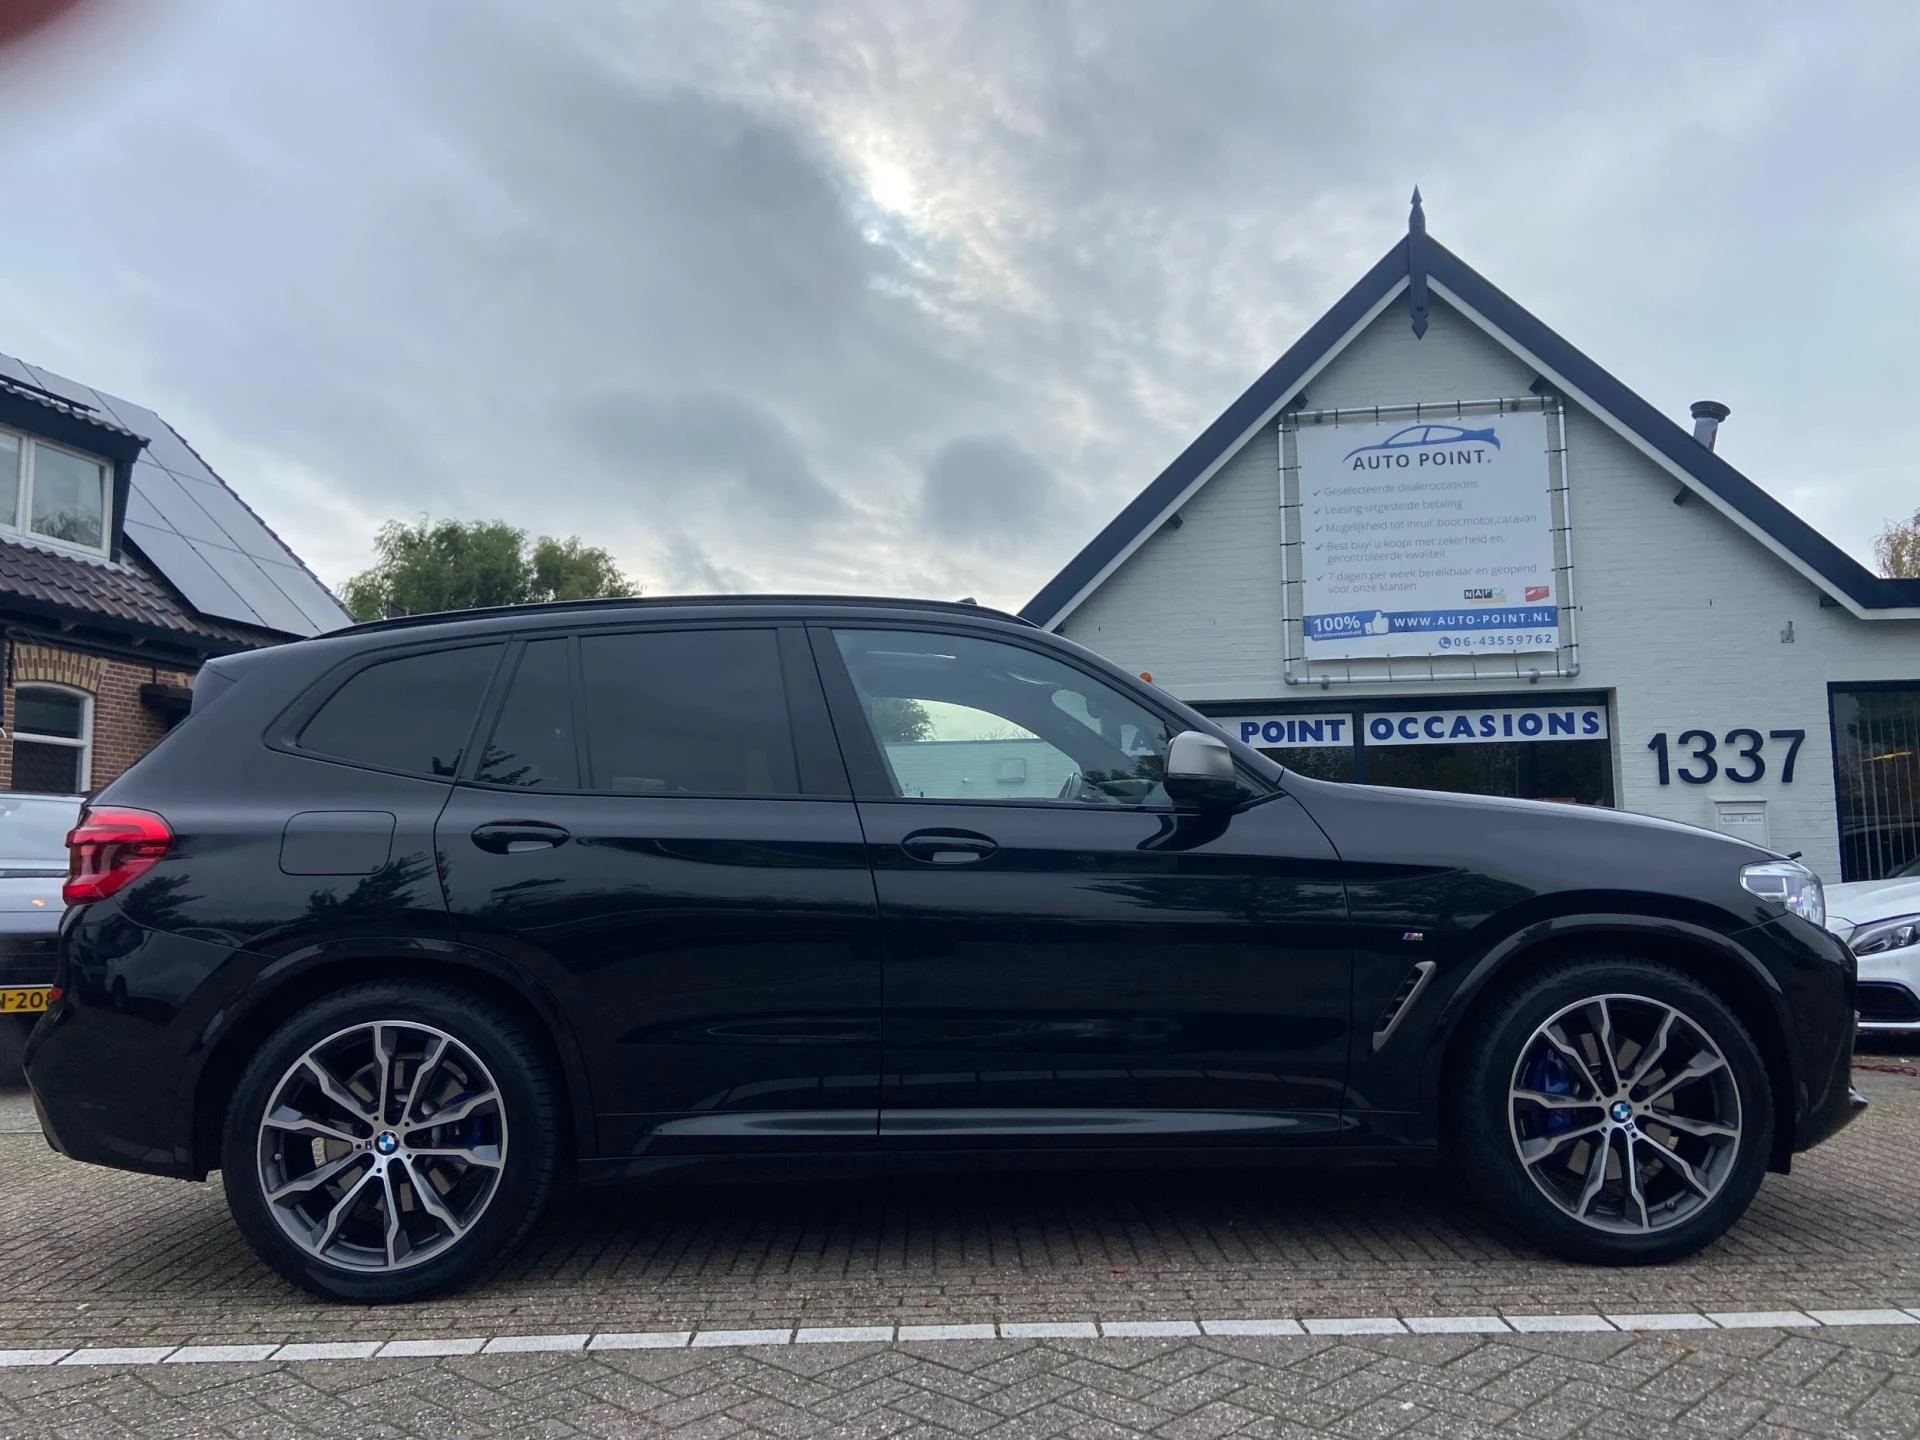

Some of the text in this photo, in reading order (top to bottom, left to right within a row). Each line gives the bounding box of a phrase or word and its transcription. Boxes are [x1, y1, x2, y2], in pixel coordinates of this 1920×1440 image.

[1353, 454, 1410, 470] AUTO
[1422, 499, 1464, 510] betaling
[1390, 519, 1404, 529] tot
[1327, 541, 1347, 551] Best
[1384, 538, 1412, 549] koopt
[1415, 537, 1434, 546] met
[1437, 534, 1487, 546] zekerheid
[1405, 550, 1446, 559] kwaliteit
[1328, 563, 1537, 583] 7 dagen per week bereikbaar en geopend
[1328, 582, 1416, 594] voor onze klanten
[1314, 615, 1361, 632] 100%
[1394, 611, 1552, 627] WWW.AUTO-POINT.NL
[1454, 633, 1552, 647] 06-43559762
[1240, 711, 1600, 744] POINT OCCASIONS
[1647, 728, 1806, 786] 1337
